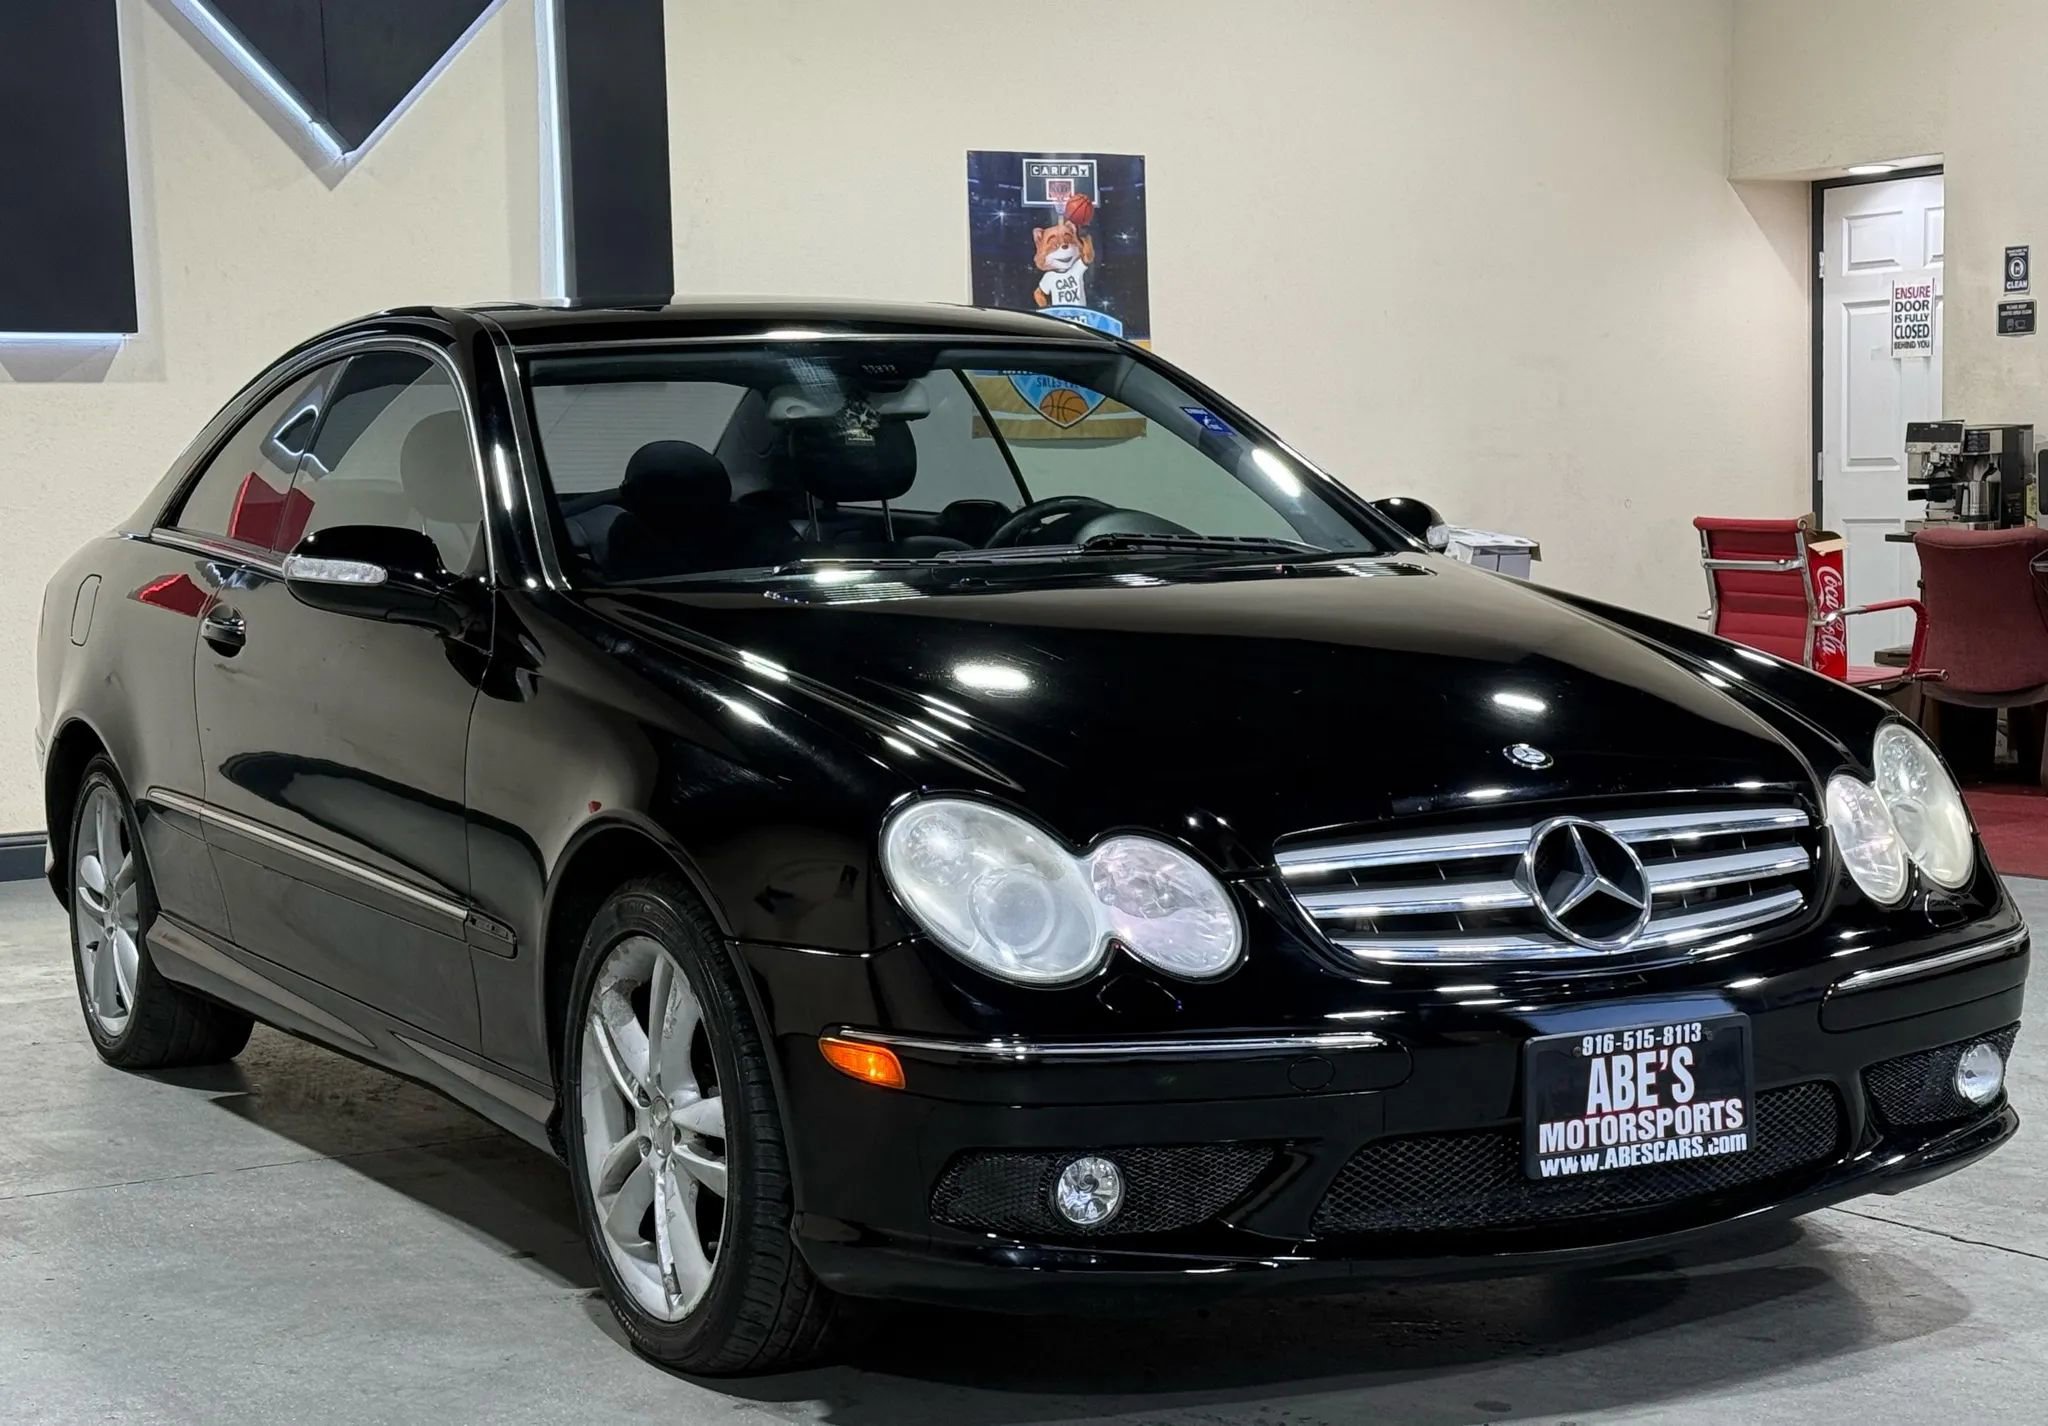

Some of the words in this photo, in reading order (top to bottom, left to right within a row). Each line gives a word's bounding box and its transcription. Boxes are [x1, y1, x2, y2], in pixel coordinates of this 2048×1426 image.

[1055, 275, 1078, 291] CAR
[2006, 280, 2028, 290] CLEAN
[1058, 288, 1080, 303] FOX
[1895, 285, 1931, 300] ENSURE
[1895, 300, 1930, 313] DOOR
[1894, 313, 1903, 324] IS
[1904, 312, 1930, 323] FULLY
[1894, 323, 1930, 340] CLOSED
[1917, 339, 1930, 349] YOU
[1581, 1022, 1702, 1057] 916-515-8113
[1586, 1046, 1695, 1116] ABE'S
[1539, 1098, 1744, 1154] MOTORSPORTS
